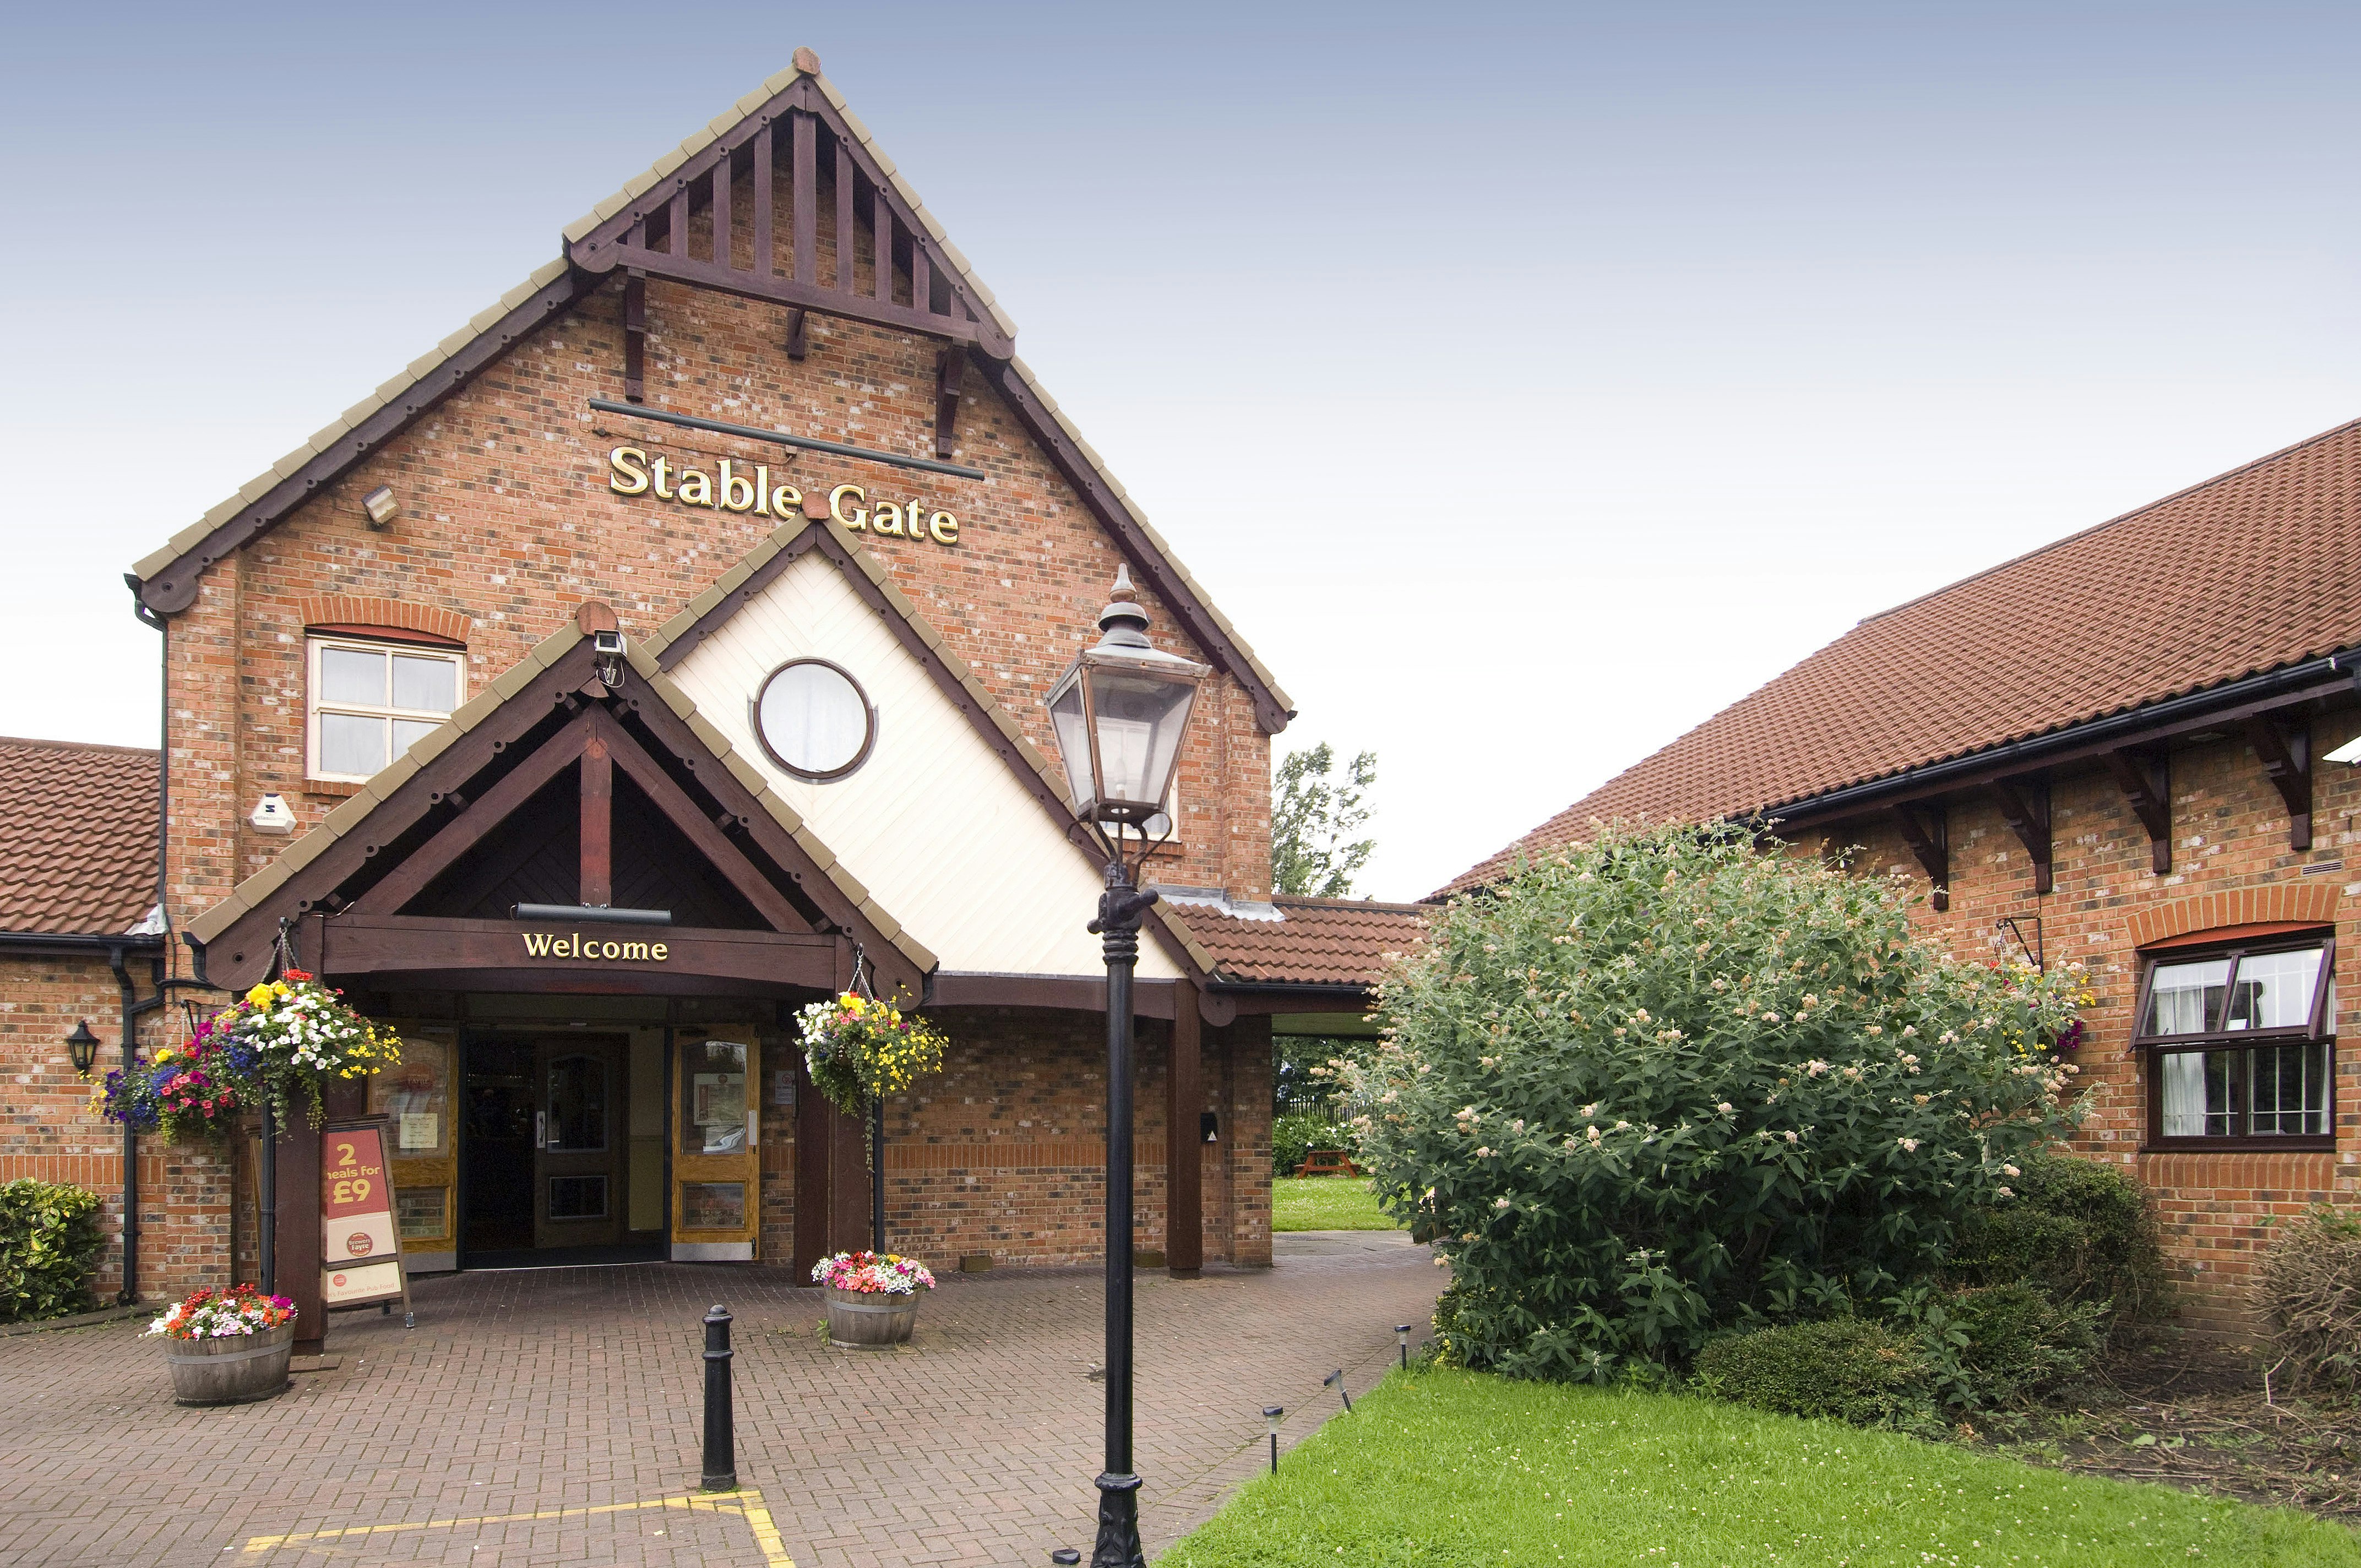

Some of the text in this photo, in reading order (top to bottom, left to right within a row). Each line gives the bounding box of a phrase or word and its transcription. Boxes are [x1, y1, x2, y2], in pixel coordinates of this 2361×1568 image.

[610, 445, 959, 545] Stable Gate
[521, 932, 668, 961] Welcome
[336, 1143, 357, 1166] 2
[361, 1165, 380, 1176] for
[333, 1178, 371, 1205] £9
